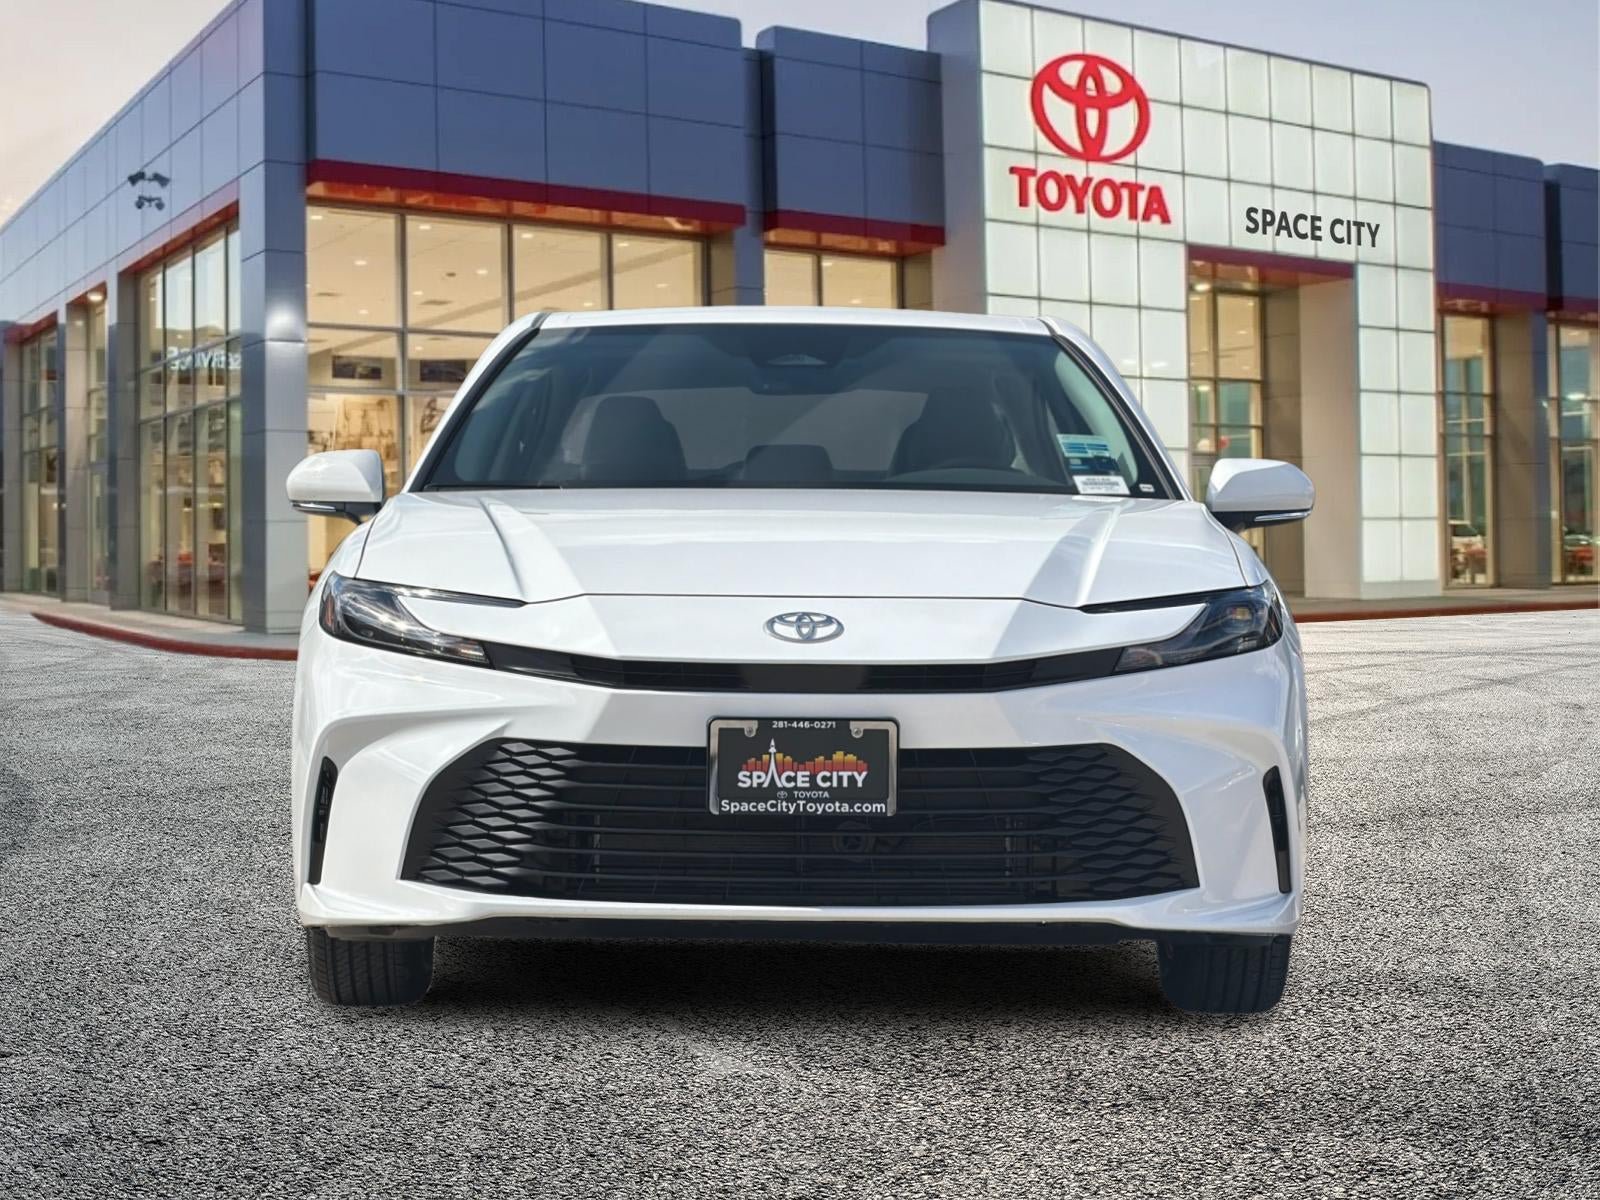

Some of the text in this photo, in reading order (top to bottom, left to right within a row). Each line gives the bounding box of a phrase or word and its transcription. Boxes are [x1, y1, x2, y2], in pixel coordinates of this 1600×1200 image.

[1009, 166, 1171, 225] TOYOTA
[1245, 206, 1380, 248] SPACE CITY
[772, 720, 837, 729] 281-446-0271
[737, 771, 868, 788] SPACE CITY
[793, 791, 830, 799] TOYOTA
[721, 799, 886, 815] SpaceCityToyota.com
